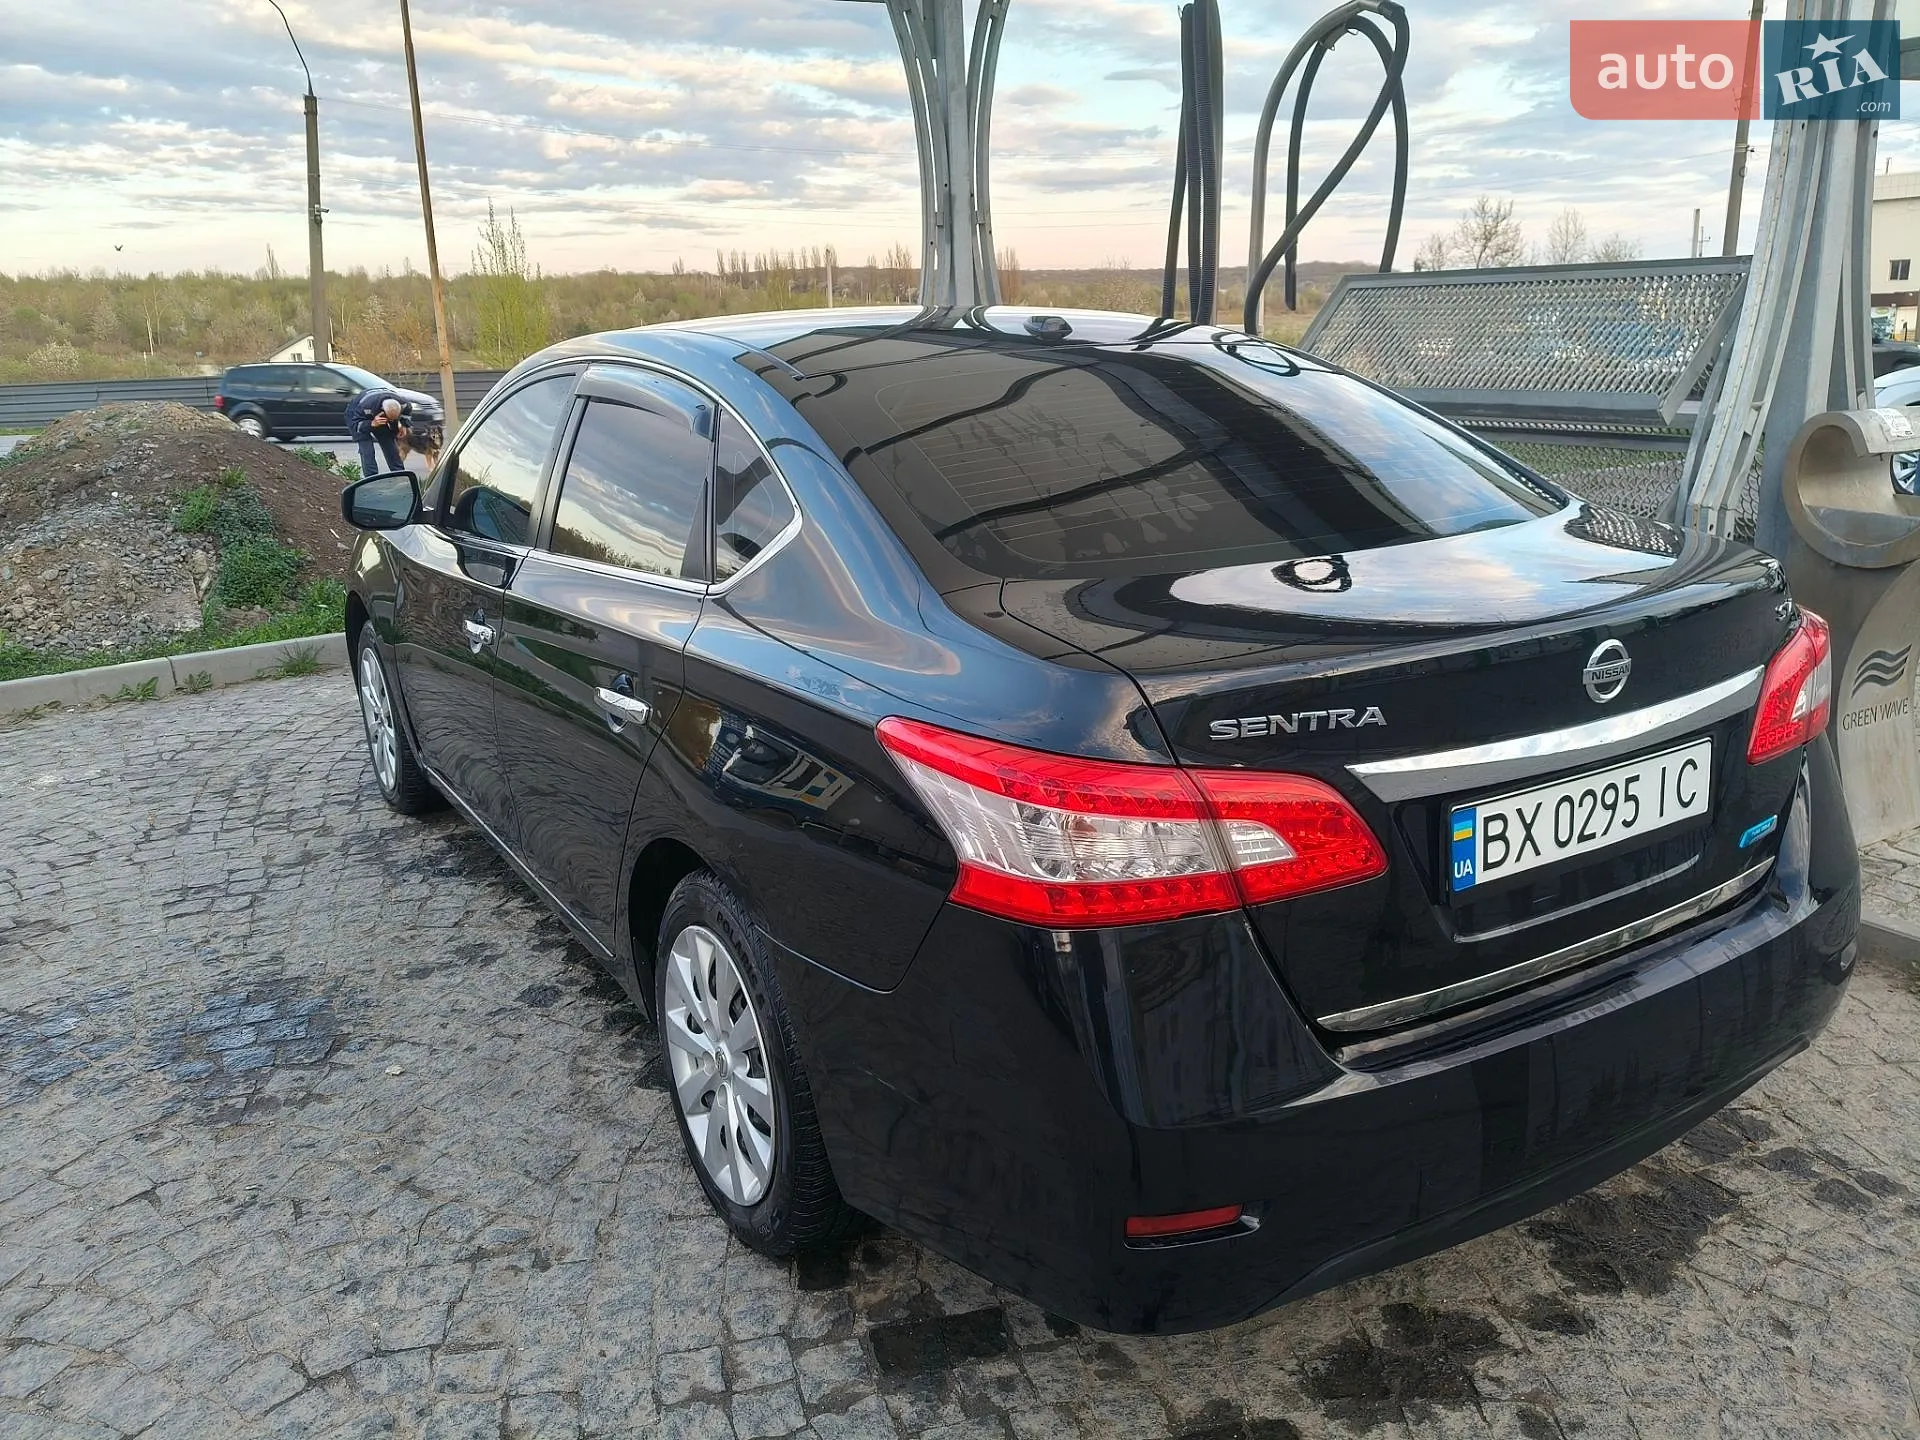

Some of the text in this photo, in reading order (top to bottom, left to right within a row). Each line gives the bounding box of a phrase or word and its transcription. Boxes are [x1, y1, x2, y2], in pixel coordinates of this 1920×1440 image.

[1592, 663, 1630, 681] NISSAN
[1209, 706, 1387, 741] SENTRA
[1842, 697, 1909, 731] GREEN WAVE
[1483, 801, 1543, 872] BX
[1554, 774, 1640, 849] 0295
[1454, 858, 1474, 879] UA
